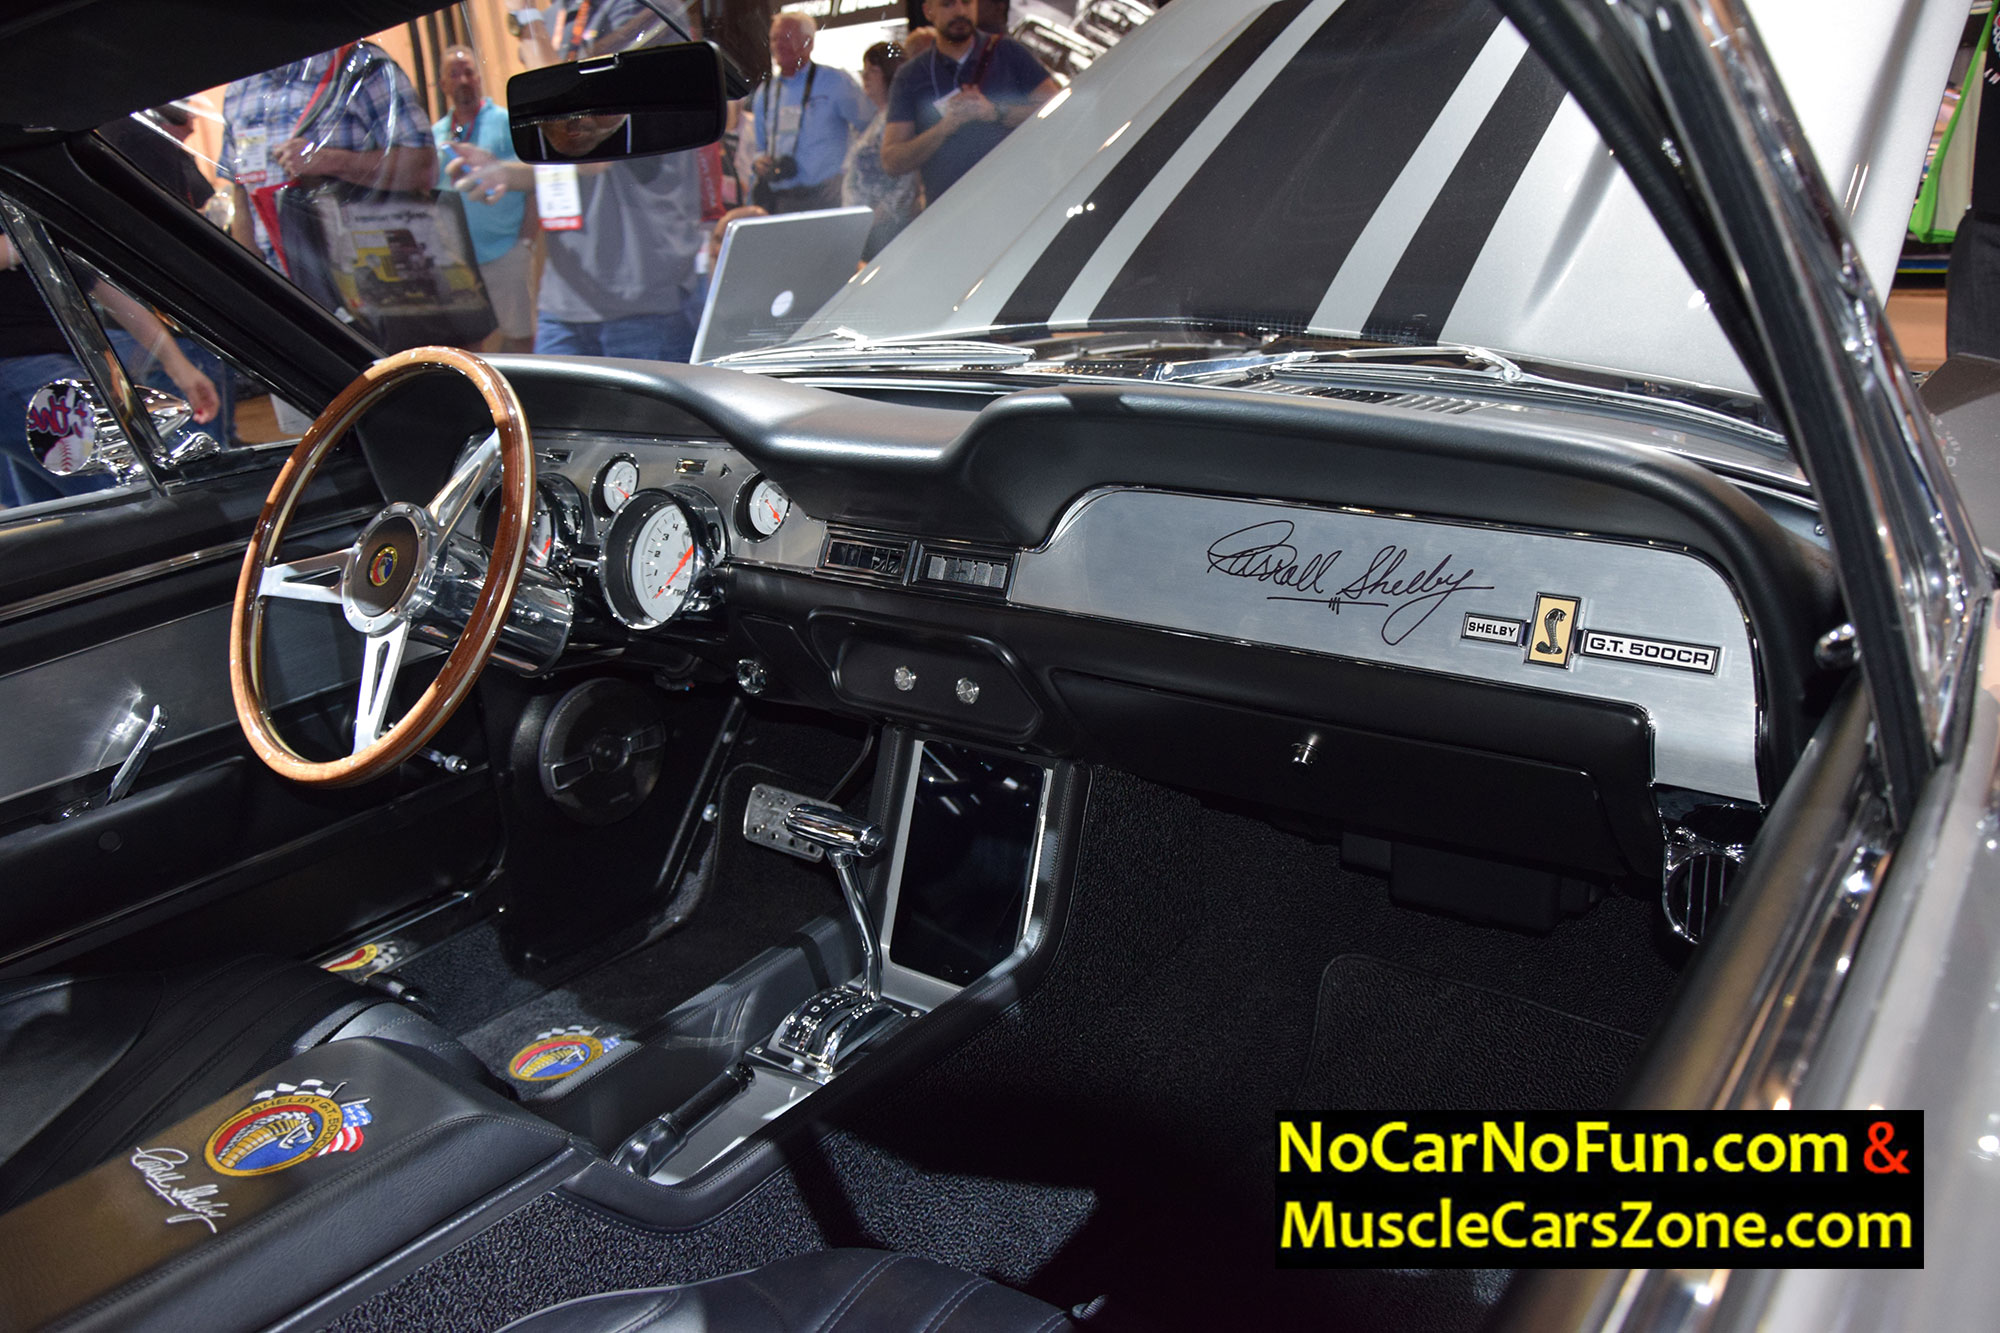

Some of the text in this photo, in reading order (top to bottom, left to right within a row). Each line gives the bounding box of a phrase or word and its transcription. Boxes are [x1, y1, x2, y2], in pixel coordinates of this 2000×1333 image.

[672, 523, 679, 532] 4
[662, 533, 670, 542] 3
[654, 550, 661, 558] 2
[1336, 546, 1495, 646] Shelby
[1468, 621, 1710, 666] SHELBY G.T. 500CR
[251, 1096, 319, 1113] SHELBY
